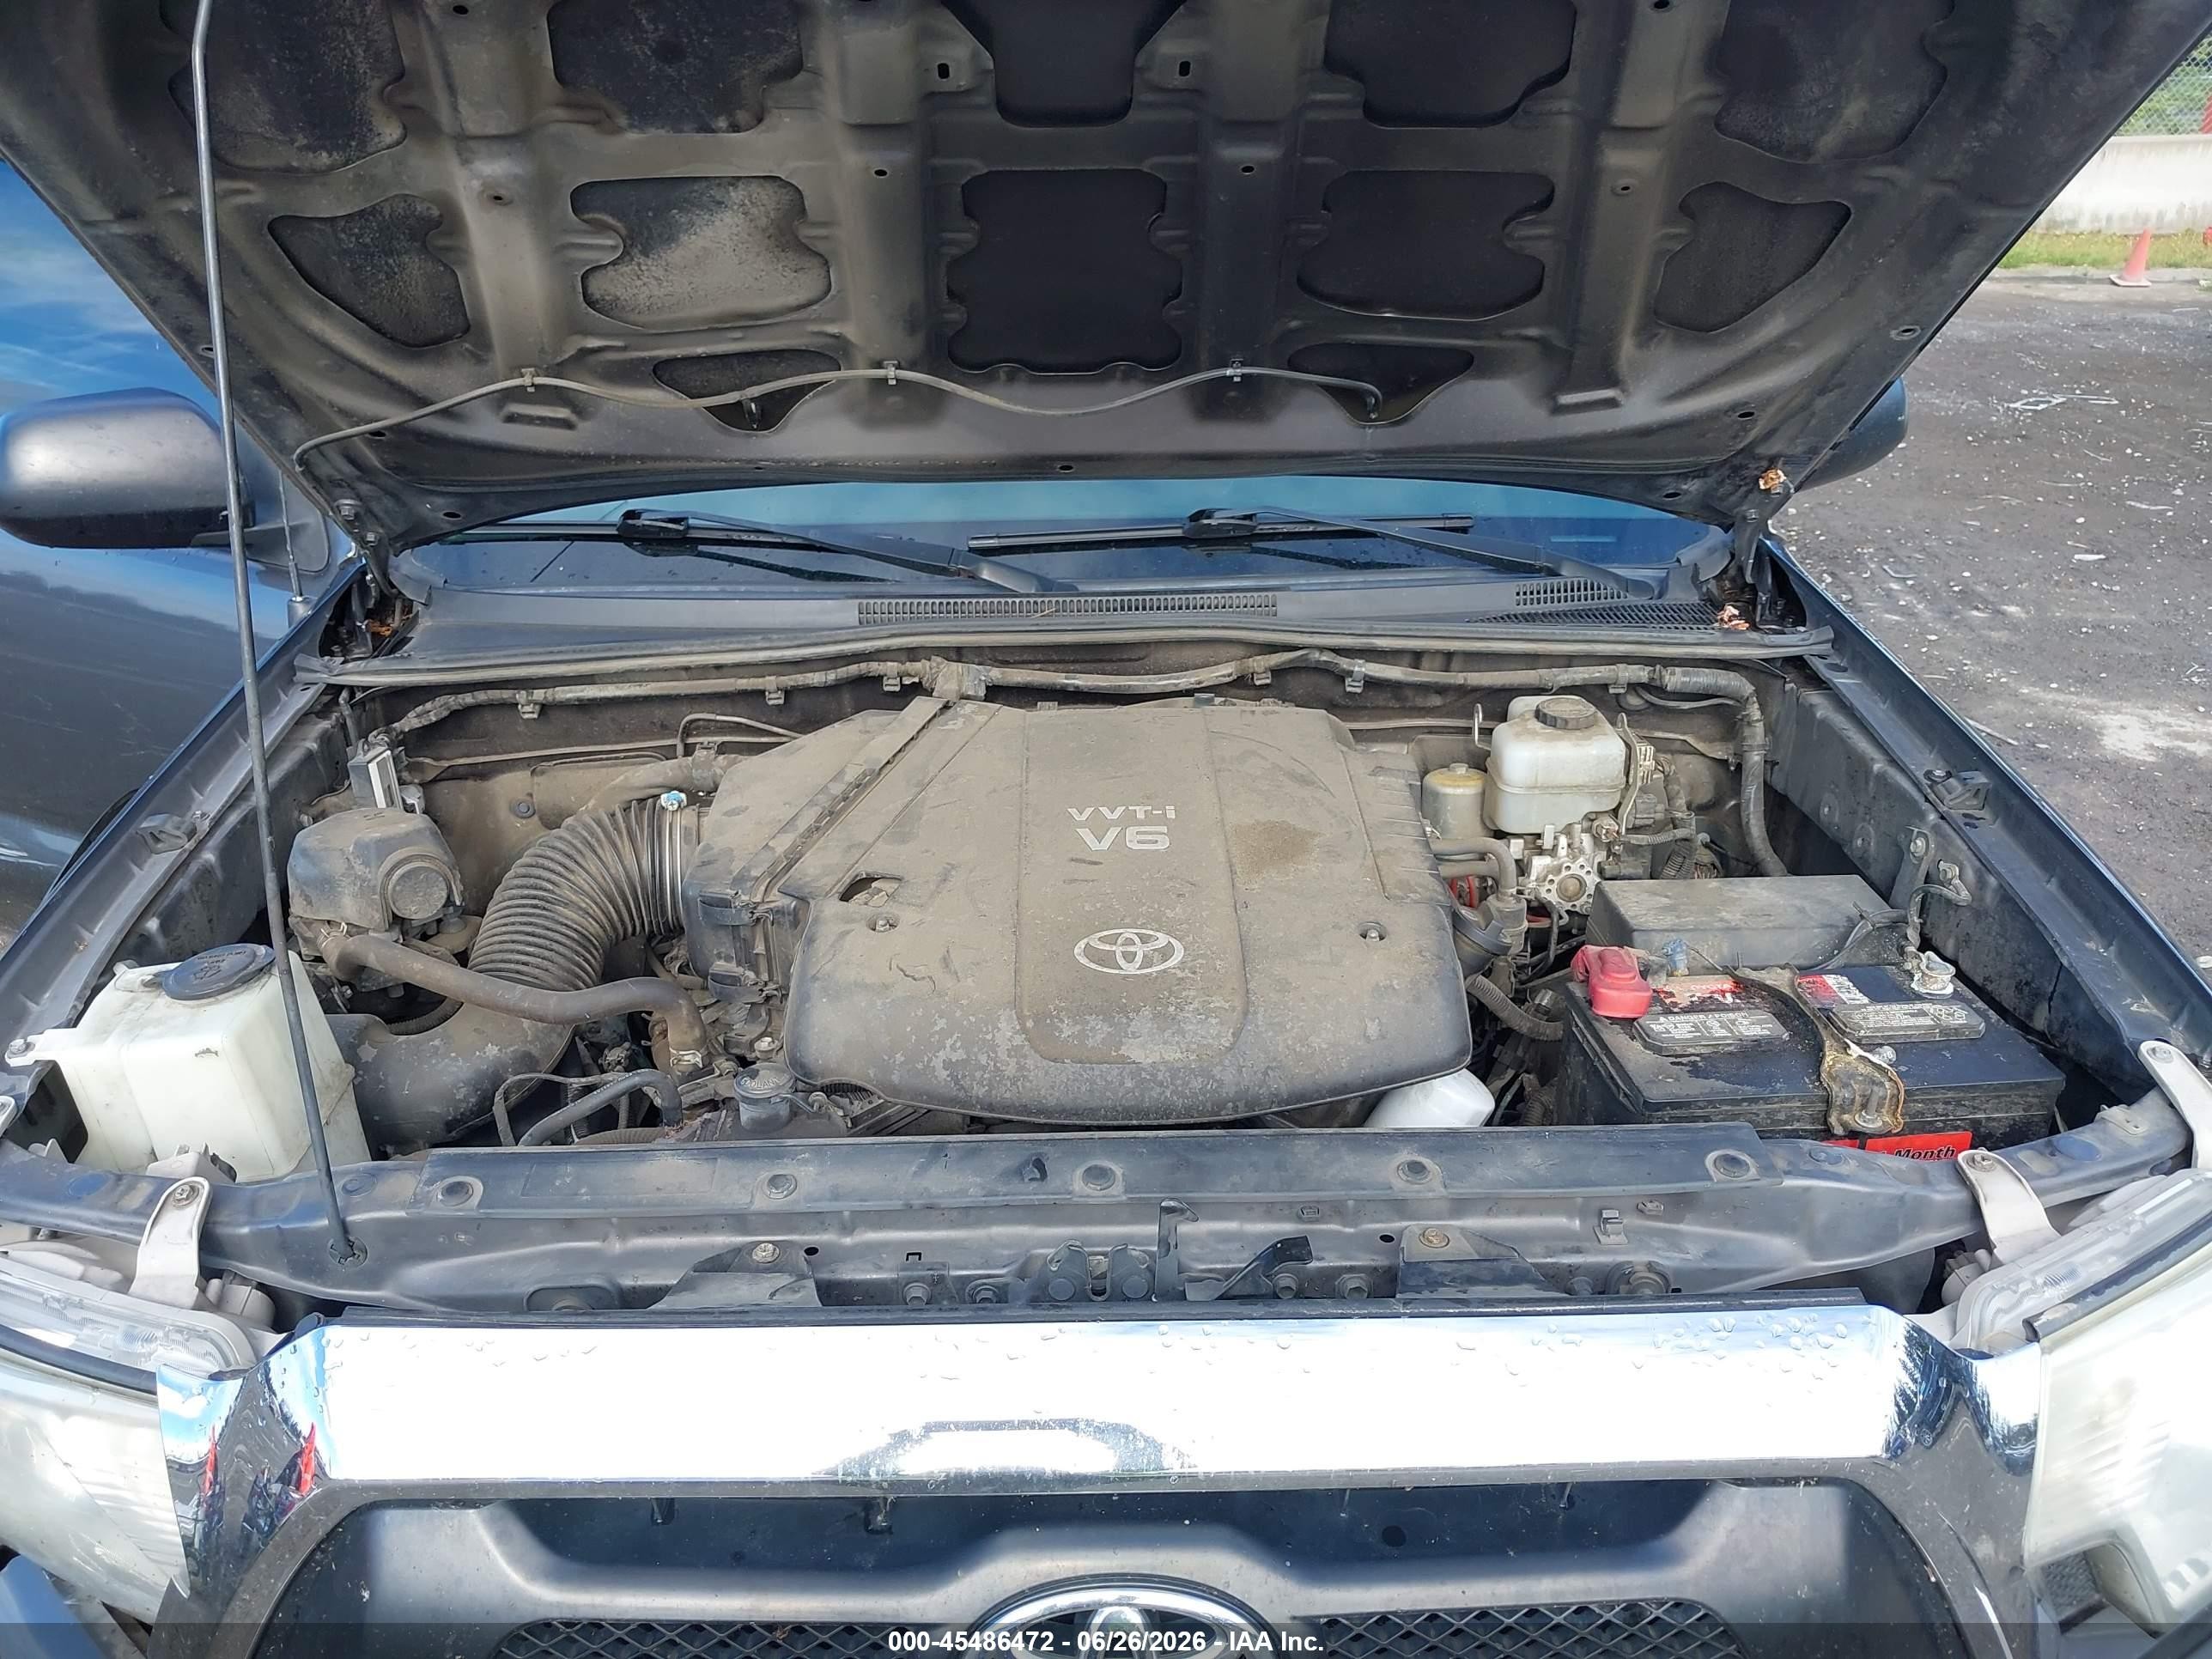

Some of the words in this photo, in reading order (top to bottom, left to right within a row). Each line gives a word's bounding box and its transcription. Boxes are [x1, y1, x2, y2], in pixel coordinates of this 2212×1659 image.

[1066, 805, 1176, 821] VVT-i
[1075, 825, 1170, 851] V6
[1894, 1145, 1957, 1160] Month
